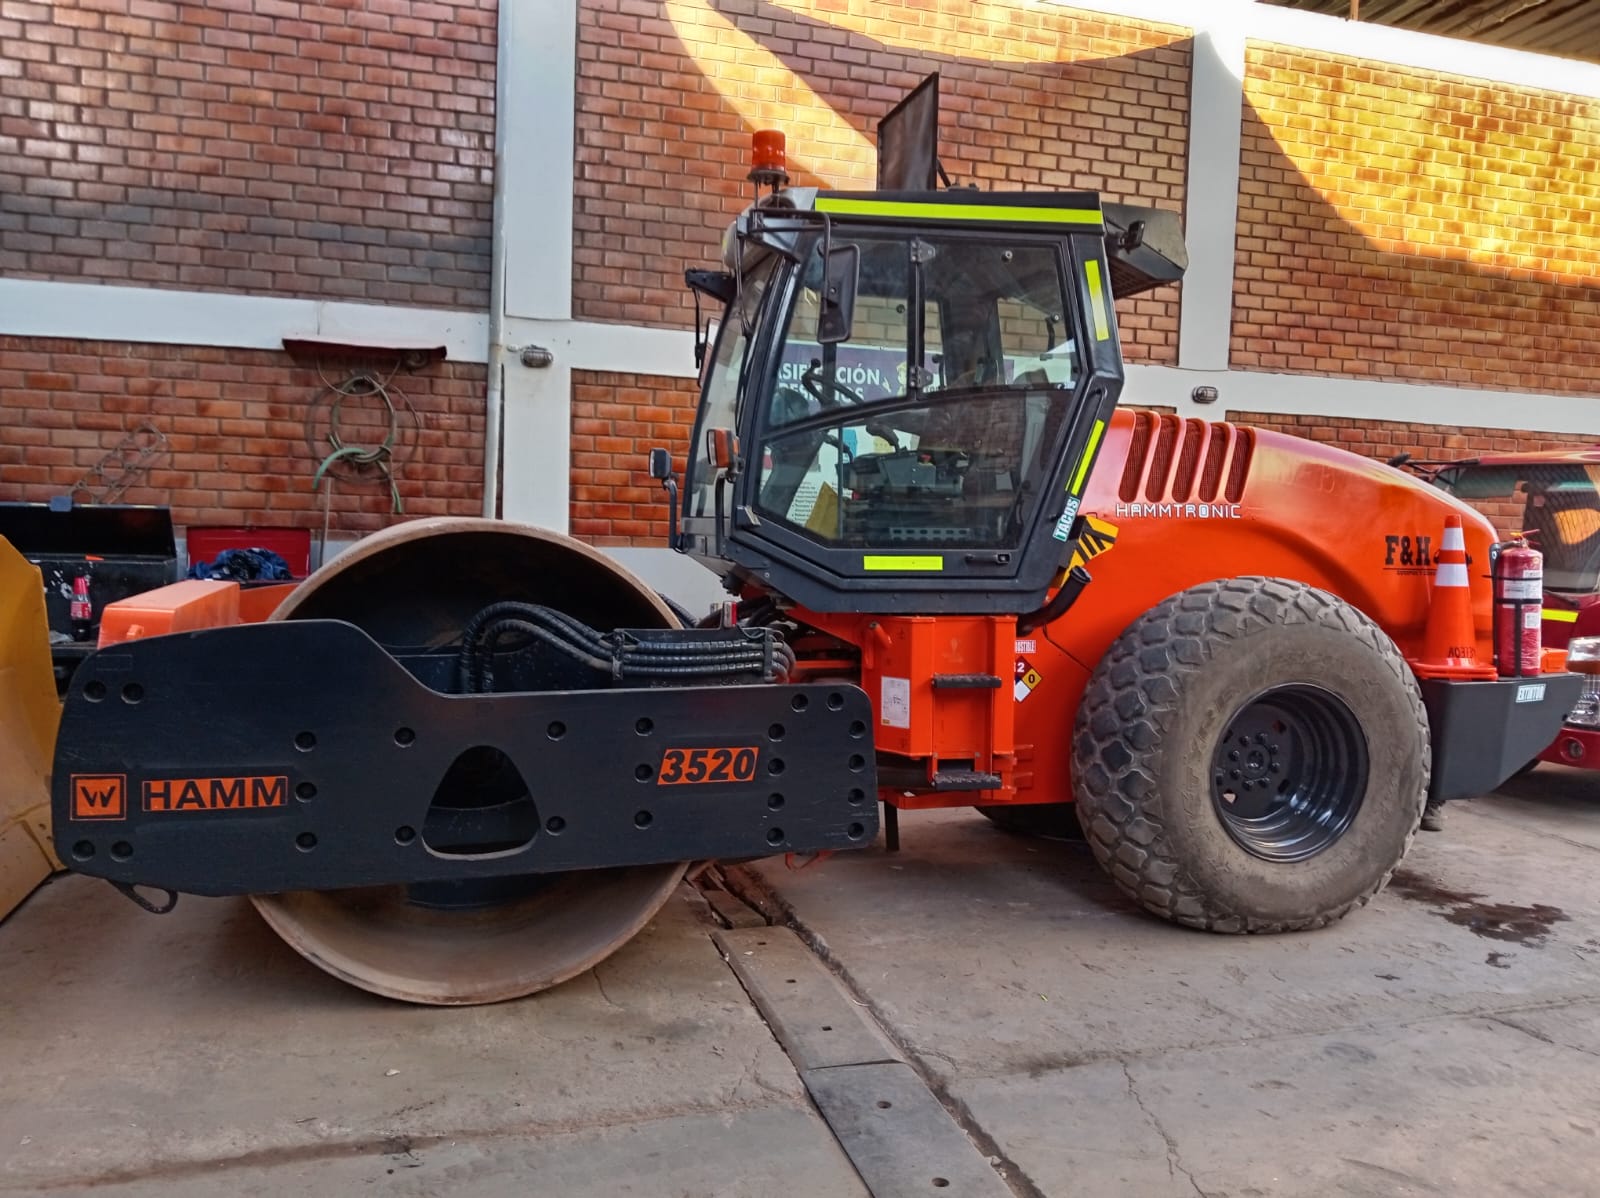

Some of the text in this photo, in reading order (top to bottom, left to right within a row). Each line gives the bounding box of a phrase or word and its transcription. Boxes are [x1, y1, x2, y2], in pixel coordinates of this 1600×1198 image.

[1055, 498, 1079, 541] TACOS
[1116, 503, 1241, 519] HAMMTRONIC
[1385, 535, 1431, 566] F&H
[1017, 662, 1025, 673] 2
[661, 749, 756, 783] 3520
[144, 778, 287, 809] HAMM
